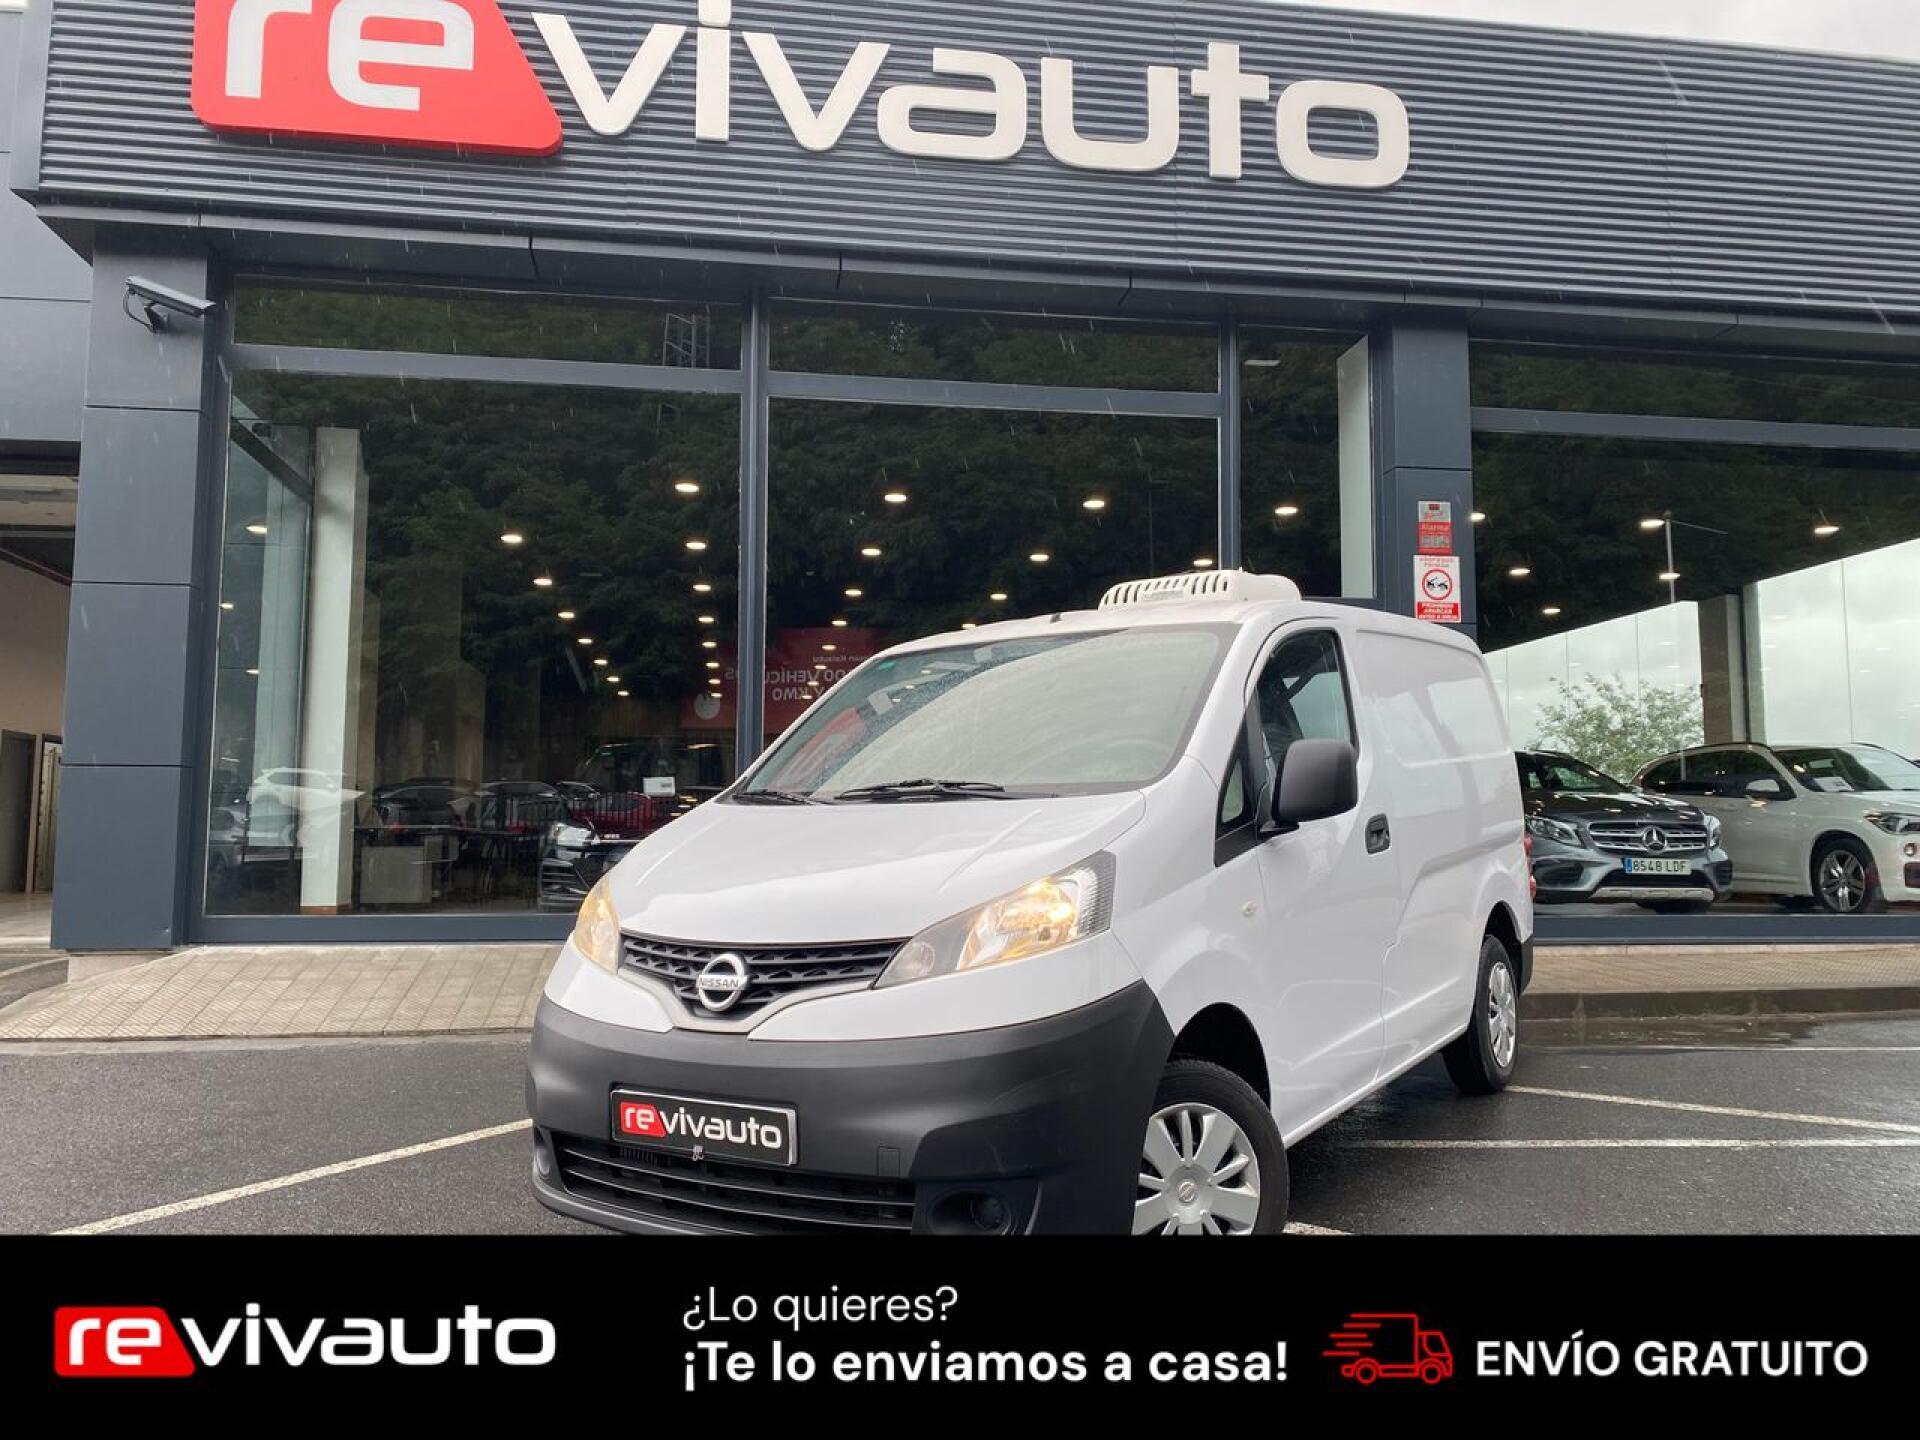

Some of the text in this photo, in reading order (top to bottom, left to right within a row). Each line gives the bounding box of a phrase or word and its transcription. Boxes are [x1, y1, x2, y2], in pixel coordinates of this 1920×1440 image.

[224, 0, 1411, 188] revivauto
[1633, 860, 1687, 873] 8548 LDF
[699, 976, 739, 988] NISSAN
[625, 1106, 782, 1149] revivauto
